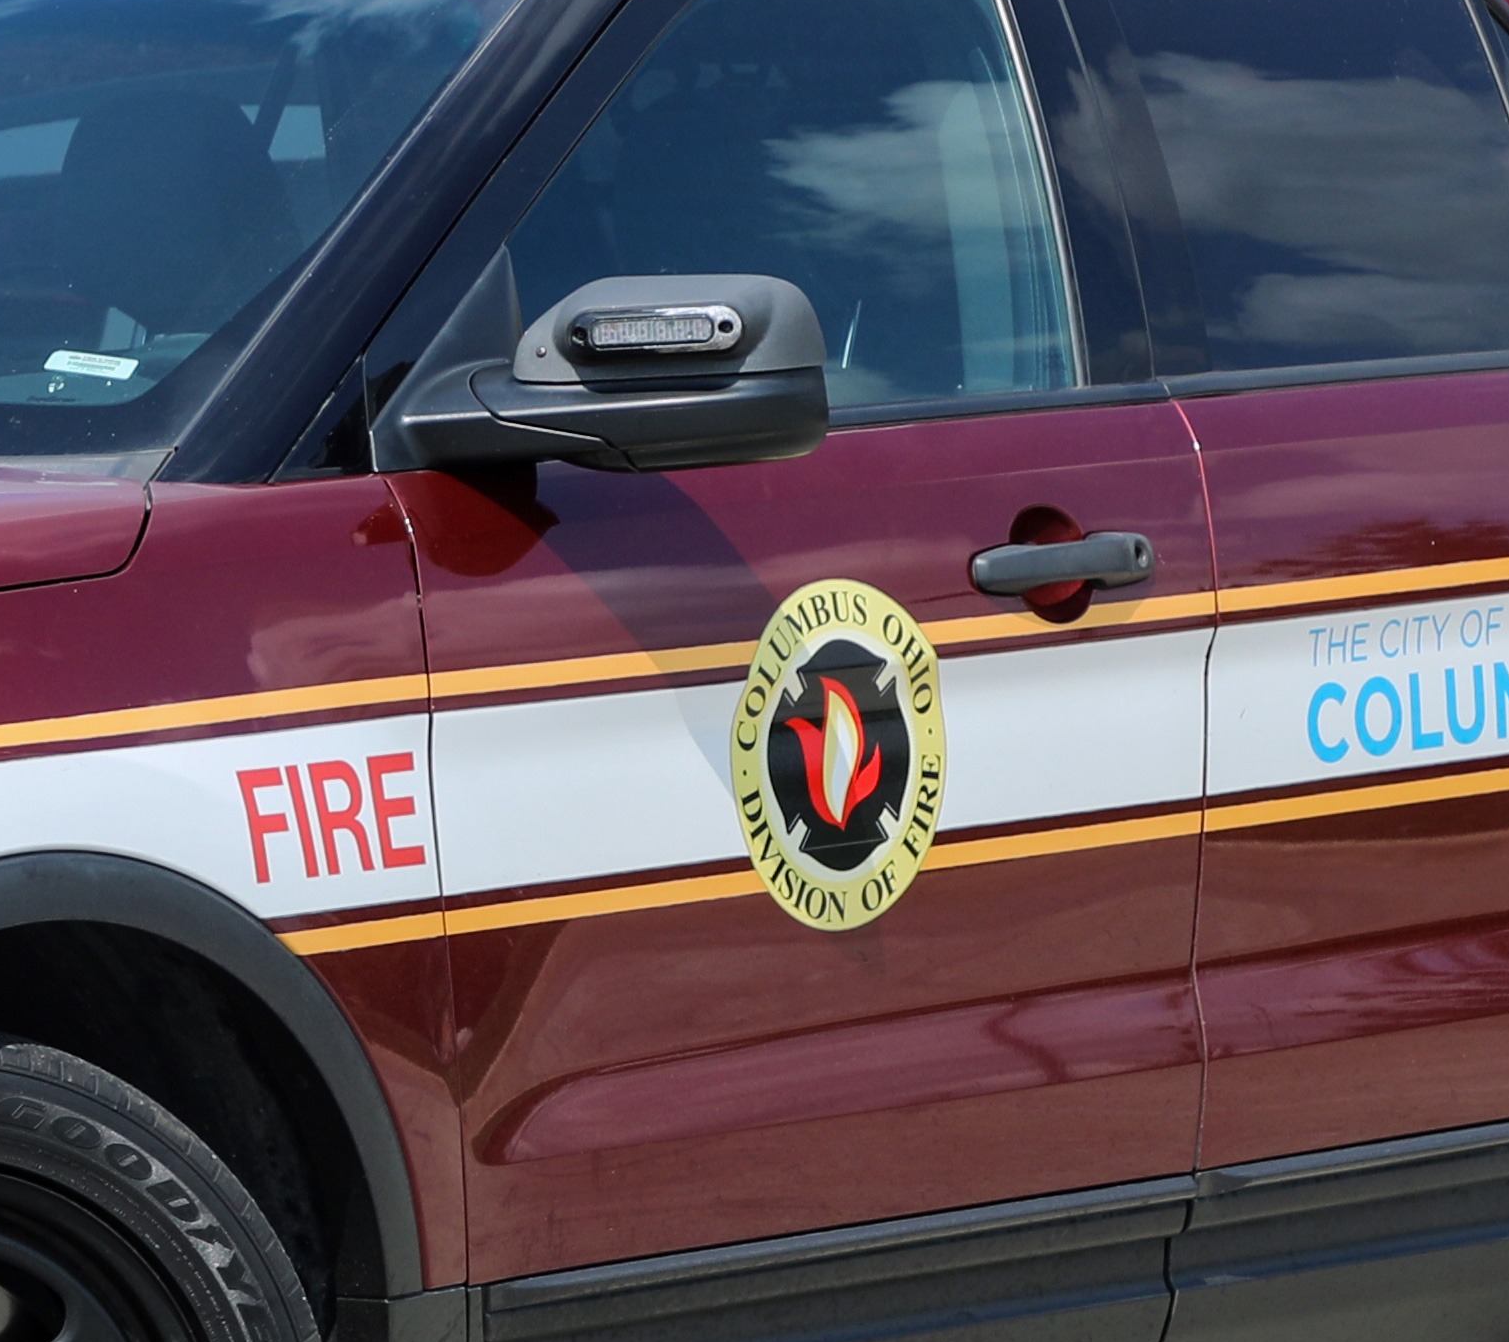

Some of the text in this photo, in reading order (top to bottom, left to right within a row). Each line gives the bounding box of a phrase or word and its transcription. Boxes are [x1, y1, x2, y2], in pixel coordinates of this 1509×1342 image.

[736, 590, 935, 752] COLUMBUS OHIO
[1308, 606, 1505, 668] THE CITY OF
[235, 750, 427, 885] FIRE
[741, 753, 943, 924] DIVISION OF FIRE
